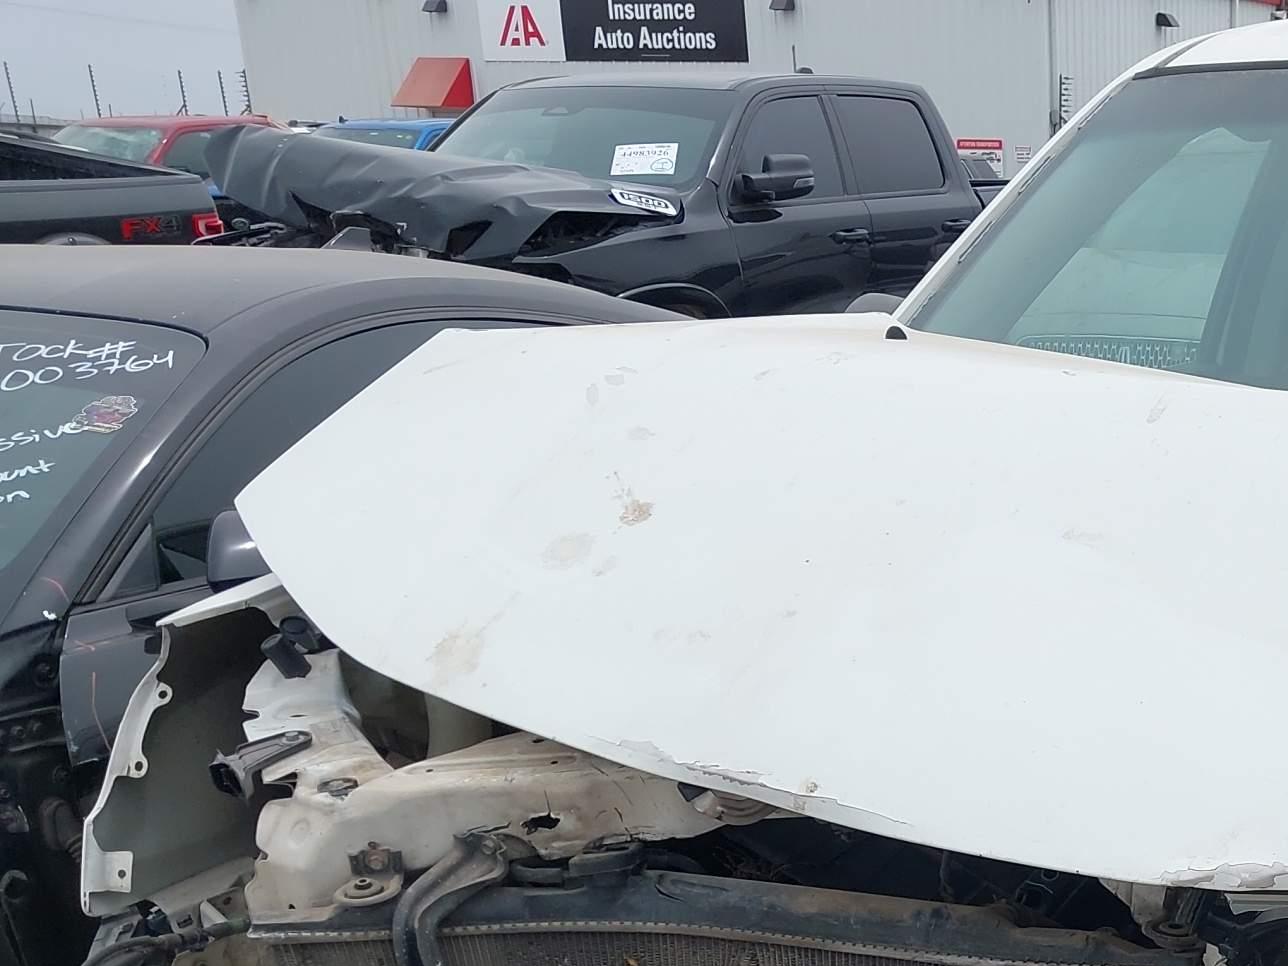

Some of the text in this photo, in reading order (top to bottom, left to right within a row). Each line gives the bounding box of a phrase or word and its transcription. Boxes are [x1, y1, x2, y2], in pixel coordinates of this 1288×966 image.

[607, 0, 696, 21] Insurance
[593, 26, 717, 50] Auto Auctions
[121, 216, 180, 241] FX4
